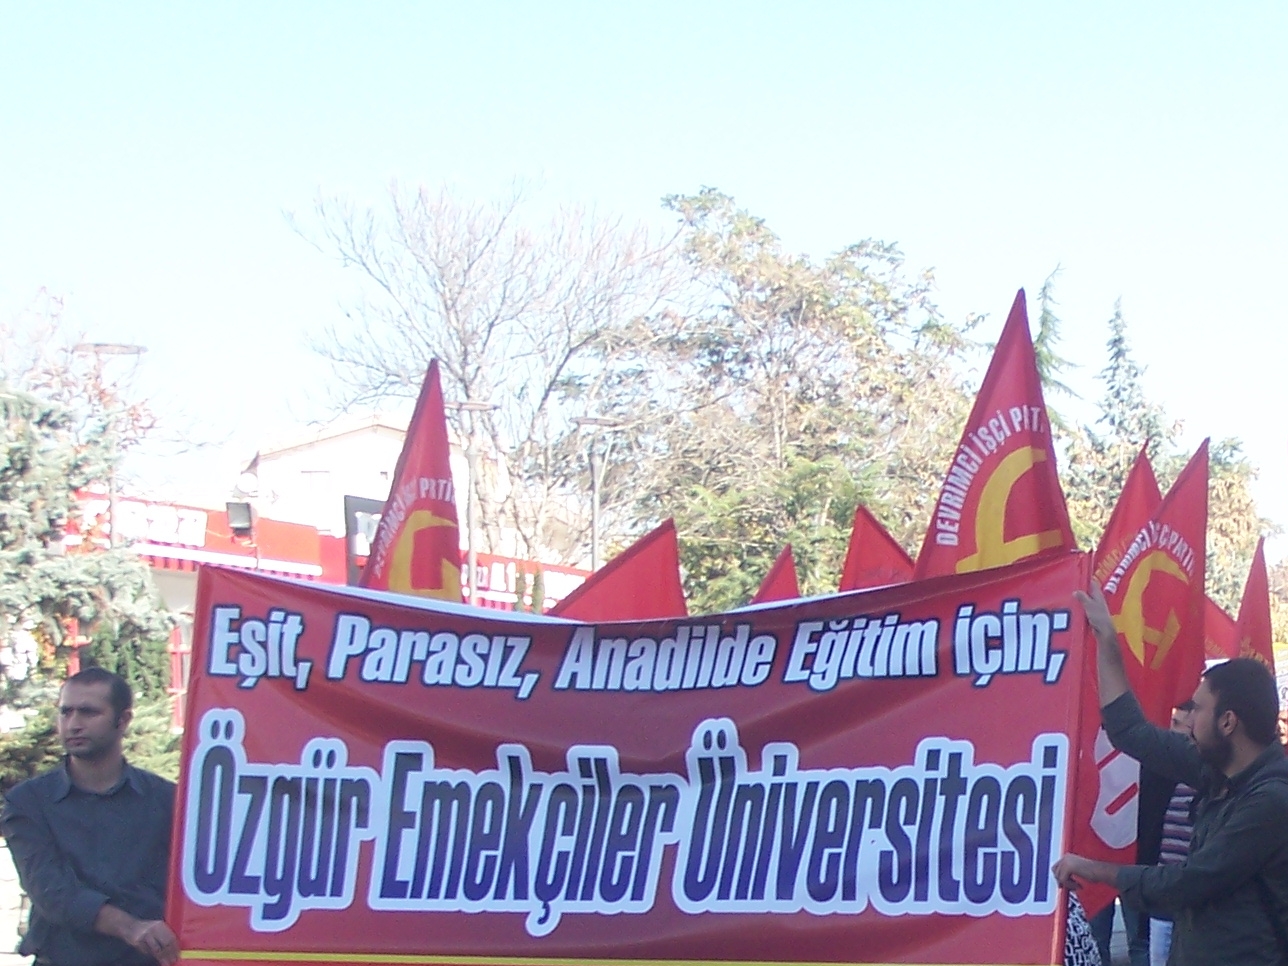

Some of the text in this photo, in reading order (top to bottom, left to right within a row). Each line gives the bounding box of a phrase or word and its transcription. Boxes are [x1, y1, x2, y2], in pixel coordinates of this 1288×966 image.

[209, 606, 313, 690] Eşit,
[326, 614, 540, 700] Parasız,
[553, 623, 779, 692] Anadilde
[783, 613, 939, 691] Eğitim
[189, 714, 375, 926] Özgür
[375, 746, 686, 930] Emekçiler
[680, 724, 1062, 910] Üniversitesi
